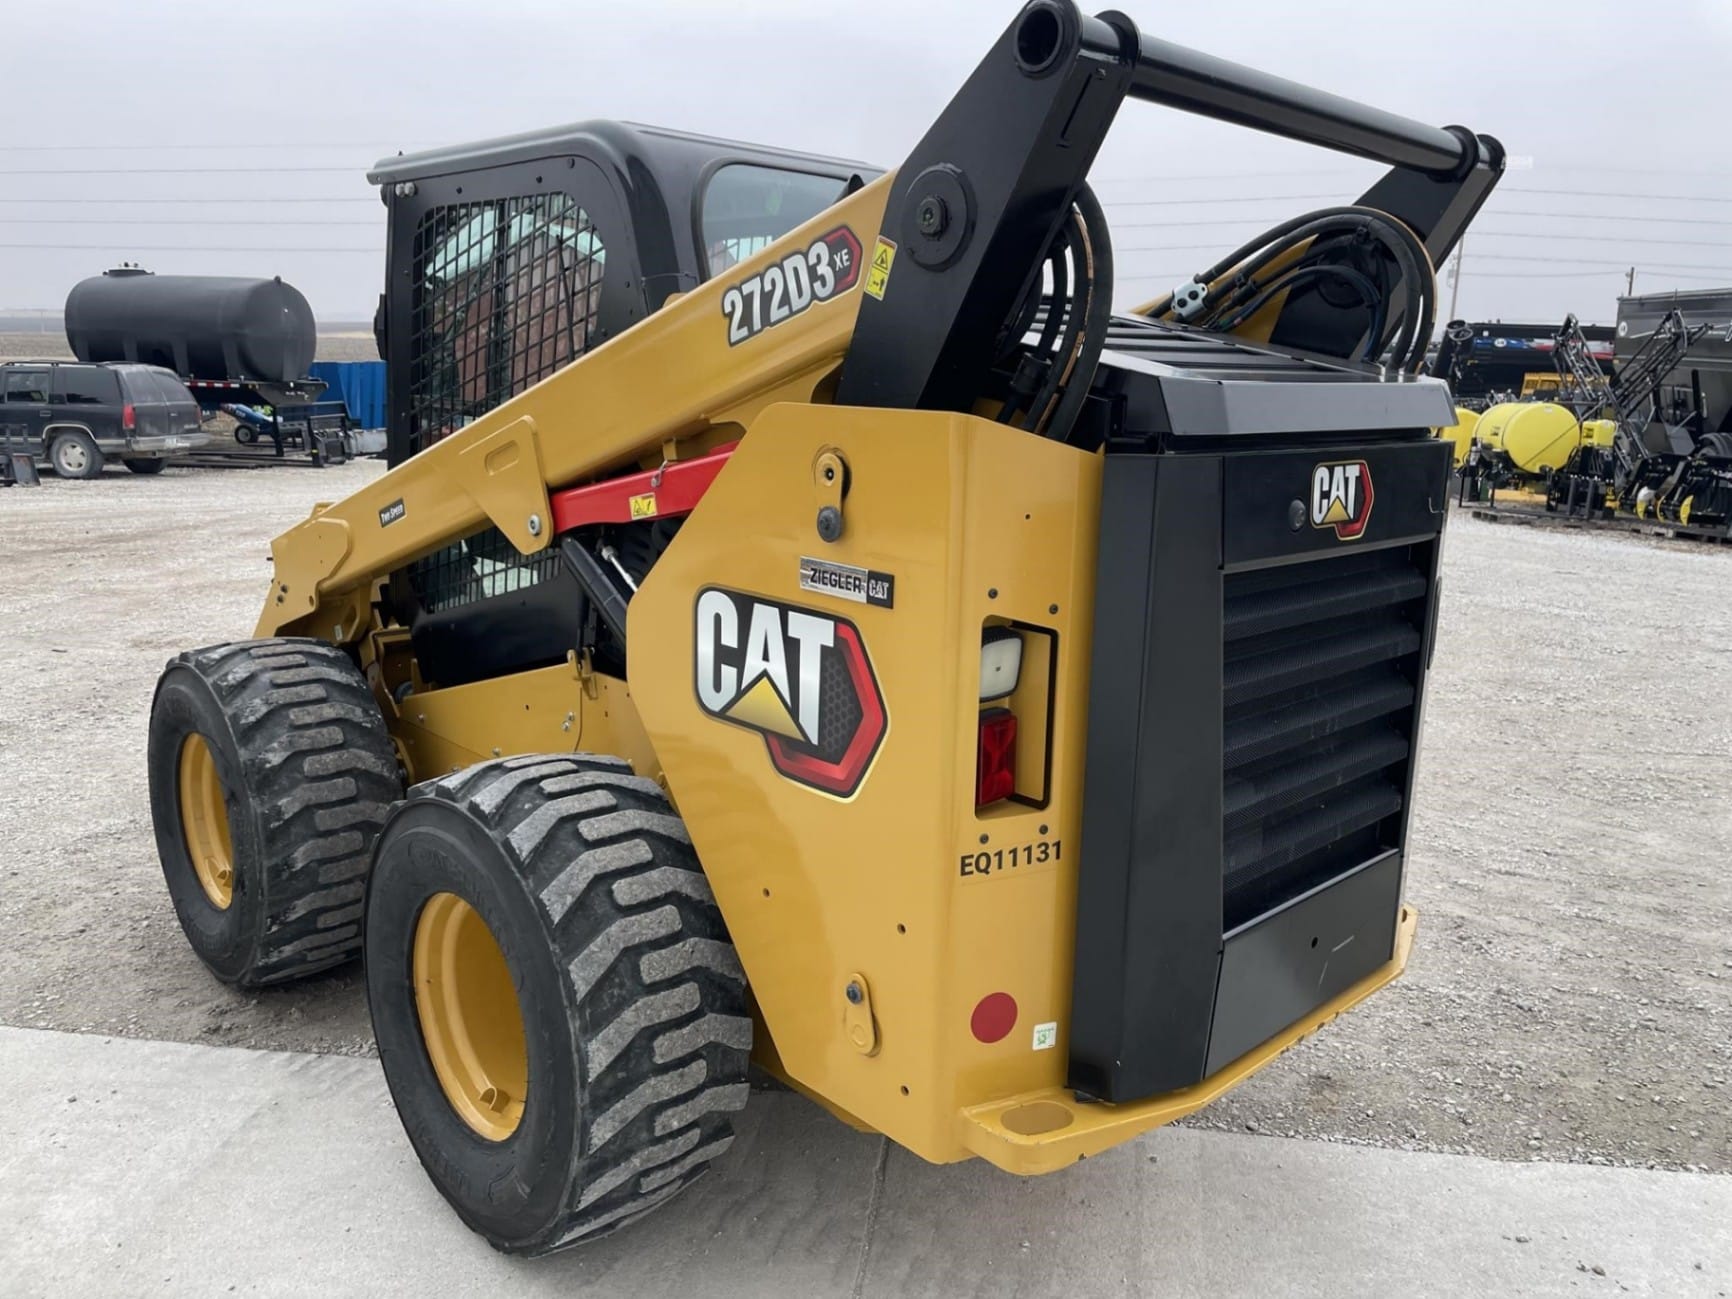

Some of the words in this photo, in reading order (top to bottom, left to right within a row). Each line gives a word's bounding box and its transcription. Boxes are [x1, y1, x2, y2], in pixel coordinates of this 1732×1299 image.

[723, 241, 836, 344] 272D3
[833, 248, 851, 271] XE
[1312, 464, 1361, 524] CAT
[809, 567, 862, 594] ZIEGLER
[868, 579, 890, 600] CAT
[696, 589, 835, 747] CAT
[959, 839, 1062, 877] EQ11131
